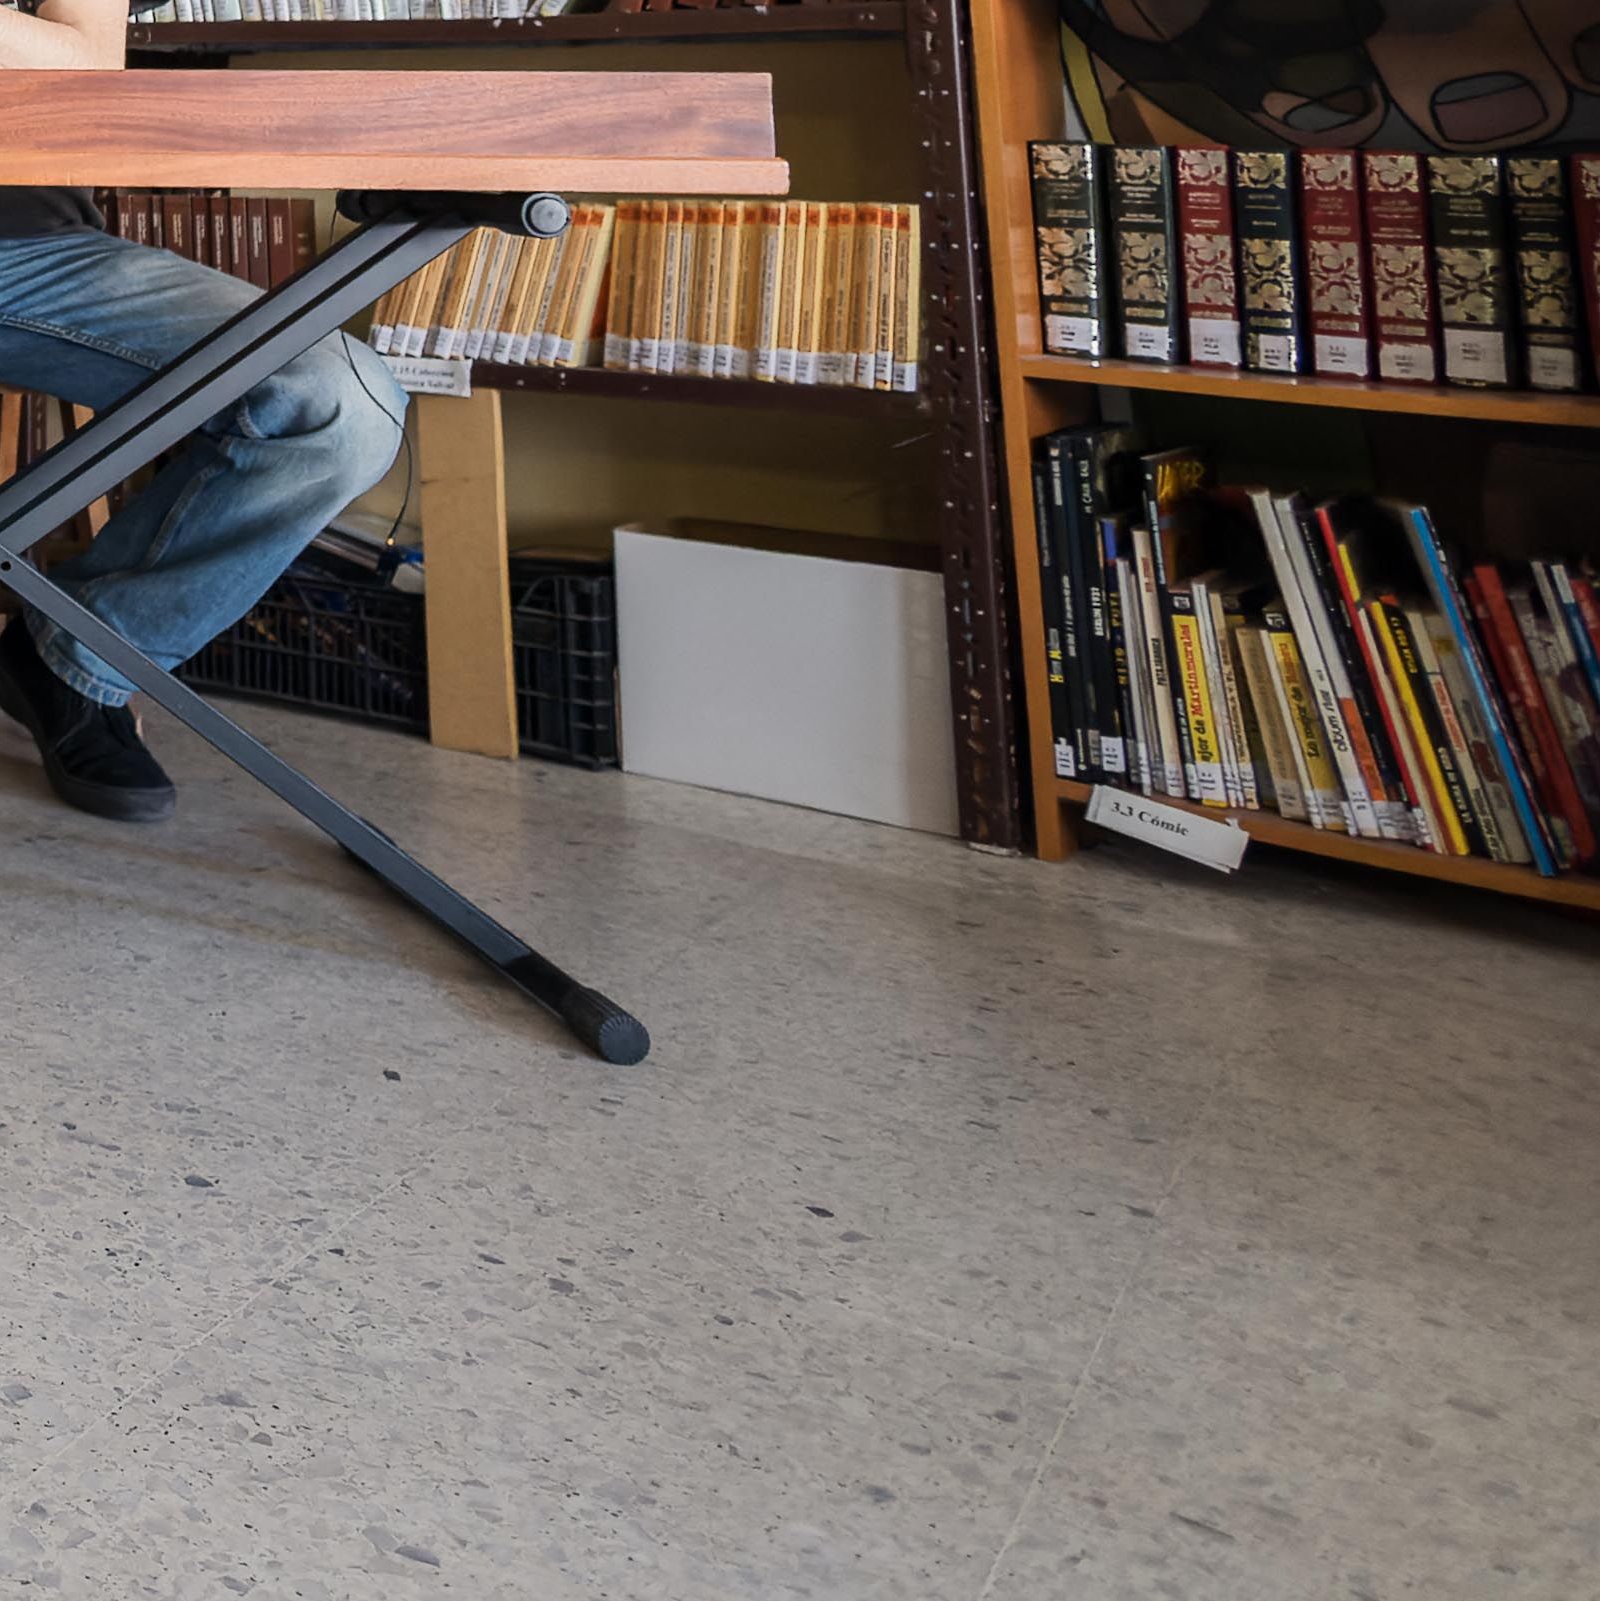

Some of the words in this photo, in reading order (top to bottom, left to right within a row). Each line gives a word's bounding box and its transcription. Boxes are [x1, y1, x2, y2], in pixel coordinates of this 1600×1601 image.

[1177, 623, 1206, 717] Martinmorales
[1289, 687, 1305, 703] de
[1193, 719, 1208, 735] de
[1294, 704, 1315, 740] mejor
[1137, 808, 1191, 838] Cómic
